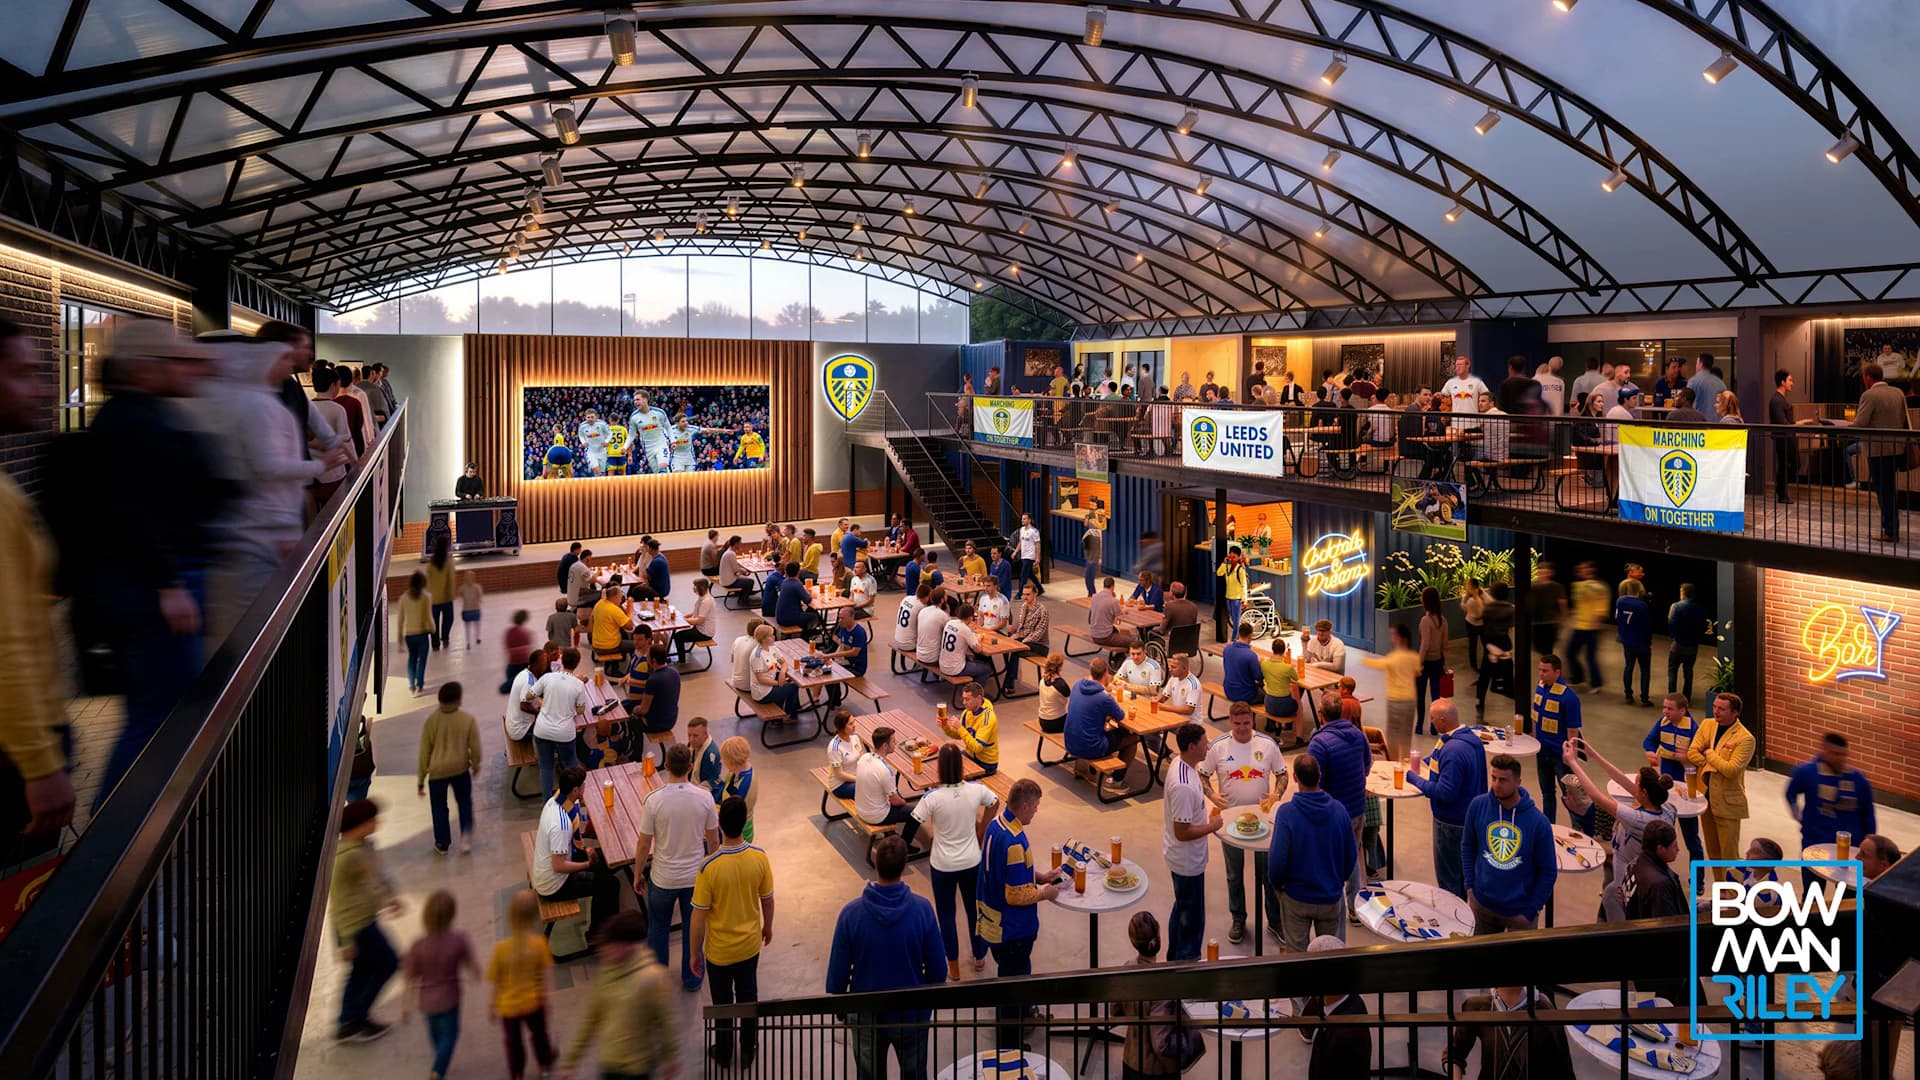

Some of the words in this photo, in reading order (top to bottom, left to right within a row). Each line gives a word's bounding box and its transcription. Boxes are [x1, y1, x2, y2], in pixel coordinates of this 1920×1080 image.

[990, 399, 1014, 407] MARCHING
[994, 435, 1019, 445] TOGETHER
[1226, 425, 1268, 441] LEEDS
[1653, 431, 1705, 448] MARCHING
[1220, 441, 1274, 460] UNITED
[1644, 507, 1658, 522] ON
[1660, 508, 1715, 527] TOGETHER
[1307, 563, 1370, 596] Dreams
[897, 606, 911, 628] 18
[942, 631, 957, 652] 18
[1803, 605, 1878, 681] Bar
